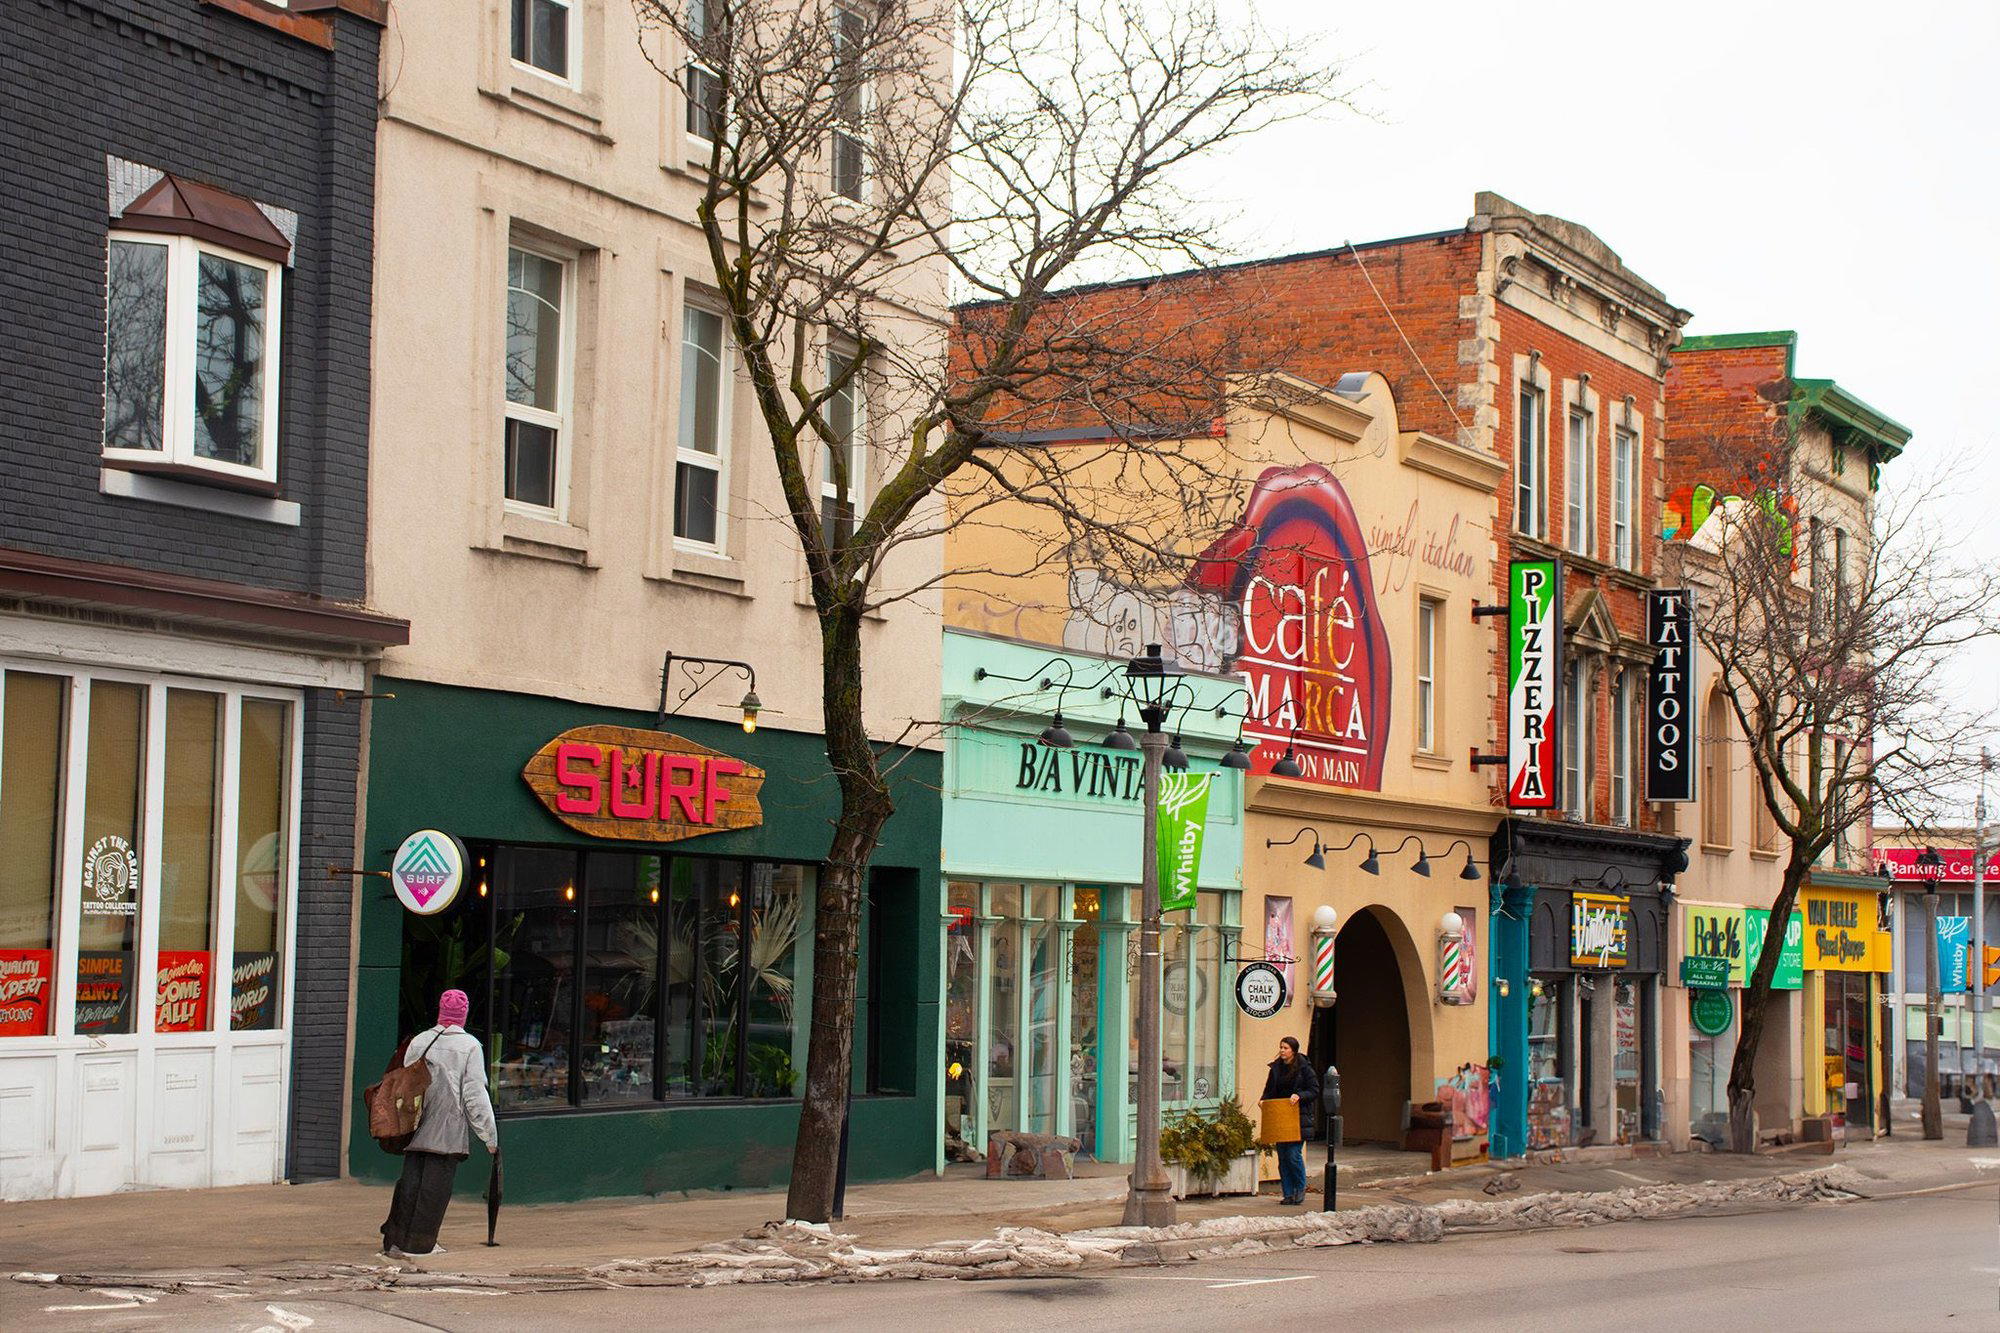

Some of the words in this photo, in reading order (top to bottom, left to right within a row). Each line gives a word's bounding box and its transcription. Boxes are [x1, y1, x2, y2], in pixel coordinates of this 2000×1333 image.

[1421, 512, 1475, 578] italian
[1242, 671, 1367, 741] MARCA
[1521, 570, 1545, 798] PIZZERIA
[1658, 596, 1682, 771] TATTOOS
[556, 743, 743, 825] SURF
[1016, 743, 1063, 793] B/A
[1322, 758, 1360, 784] MAIN
[84, 836, 108, 889] AGAINST
[110, 835, 129, 852] THE
[126, 850, 138, 889] GRAIN
[406, 874, 445, 884] SURF
[1176, 819, 1202, 900] Whitby
[1890, 859, 1947, 879] Banking
[83, 901, 104, 909] TATTOO
[105, 902, 137, 910] COLLECTIVE
[79, 958, 122, 974] SIMPLE
[1952, 942, 1966, 987] Whitby
[1248, 985, 1274, 994] CHALK
[1250, 995, 1272, 1004] PAINT
[157, 1001, 197, 1026] ALL!
